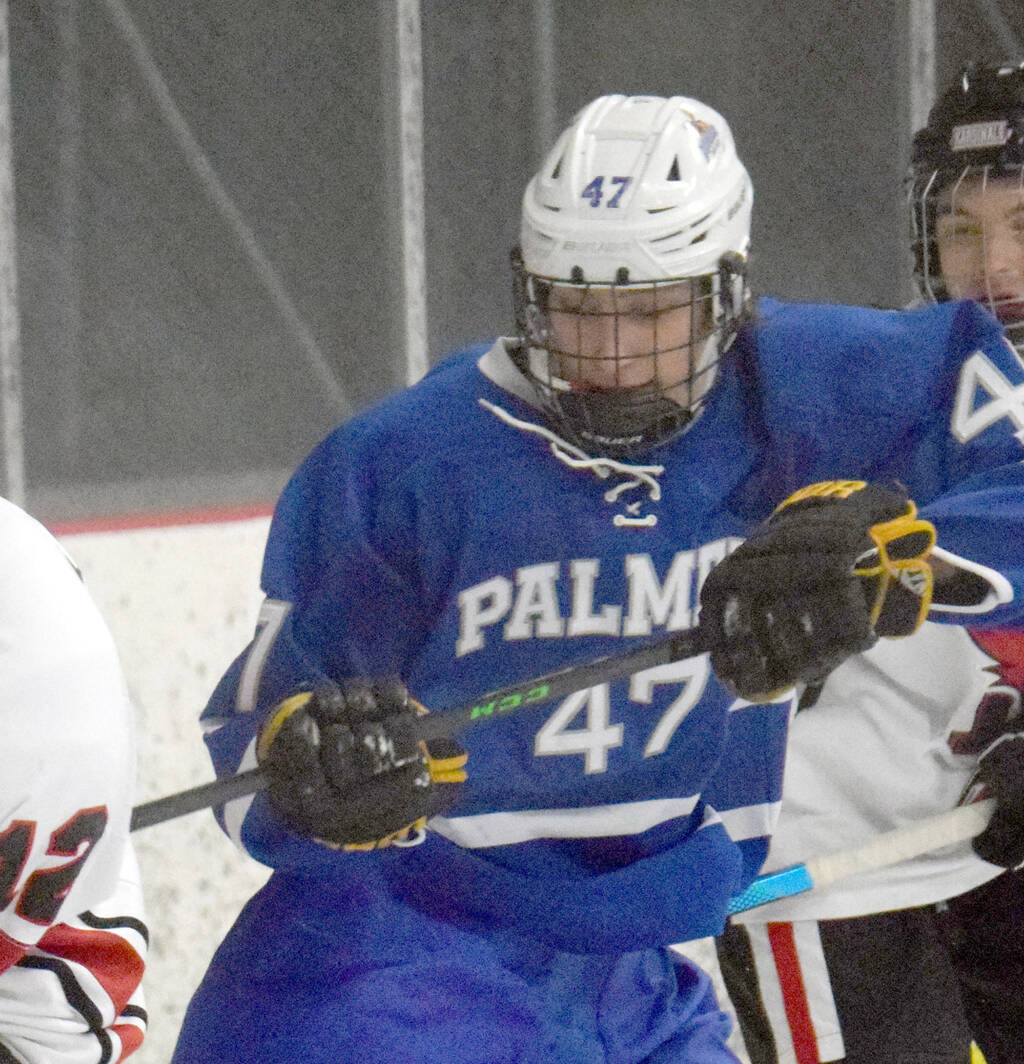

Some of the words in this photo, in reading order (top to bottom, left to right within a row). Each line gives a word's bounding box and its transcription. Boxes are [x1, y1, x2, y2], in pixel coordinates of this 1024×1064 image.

[581, 176, 633, 208] 47
[950, 350, 1024, 444] 4
[533, 653, 712, 775] 47
